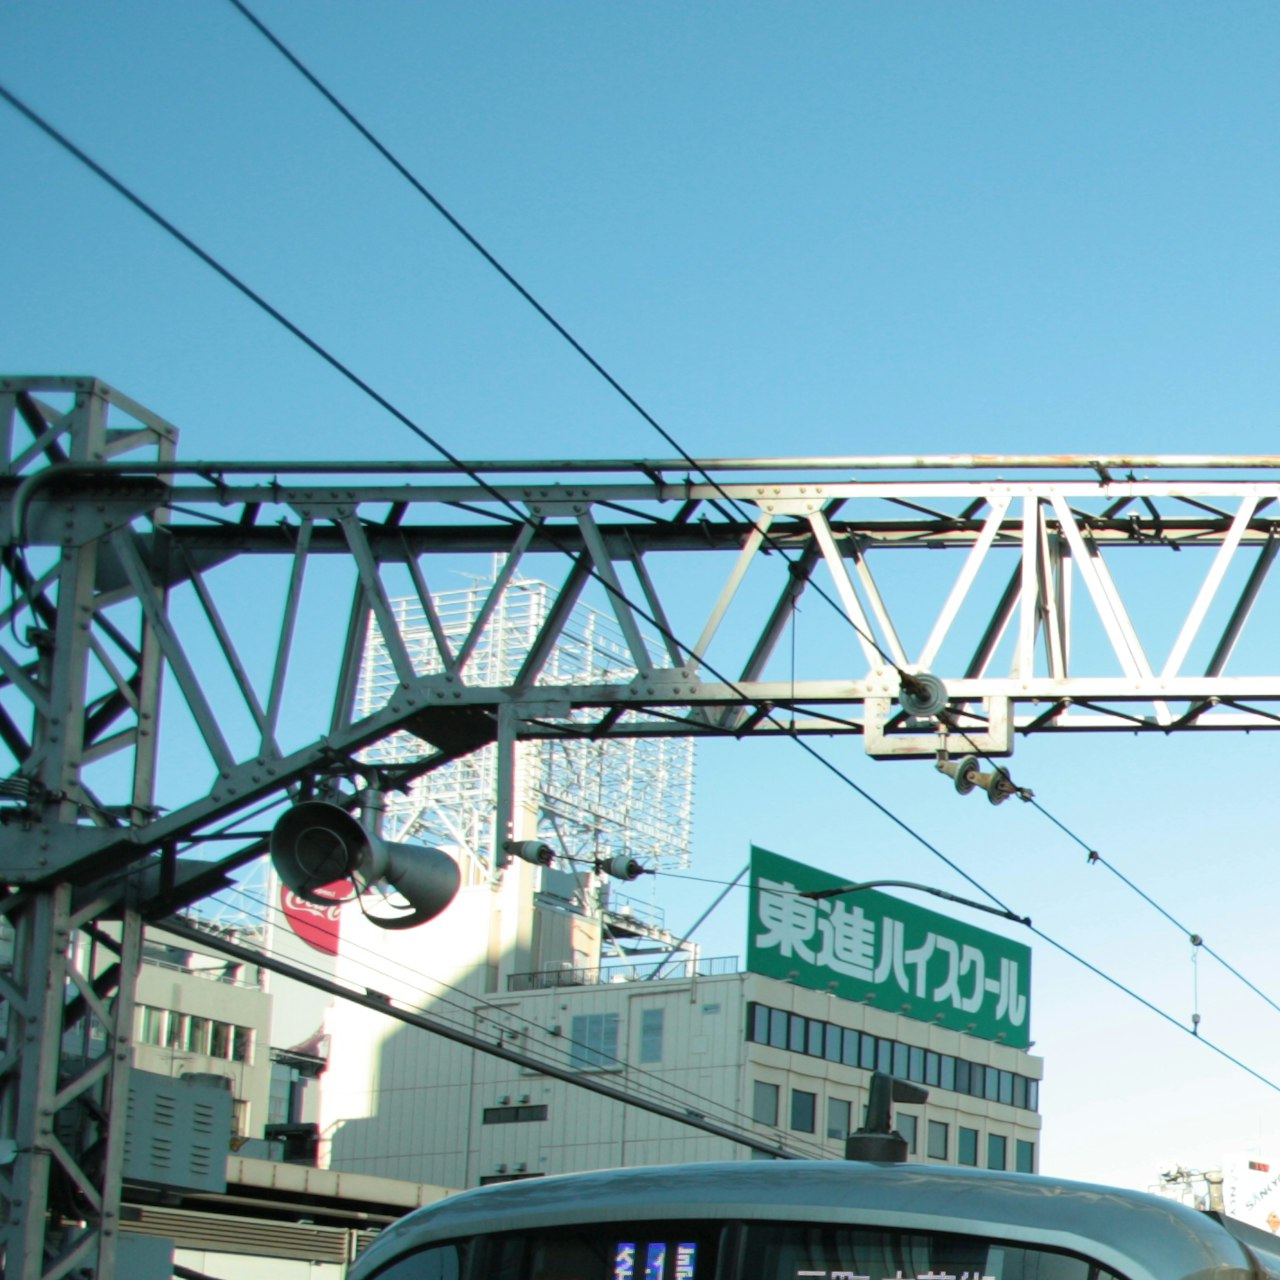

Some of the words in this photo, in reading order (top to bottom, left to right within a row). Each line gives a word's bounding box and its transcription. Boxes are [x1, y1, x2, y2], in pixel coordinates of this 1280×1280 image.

[754, 876, 1027, 1027] 東進ハイスクール
